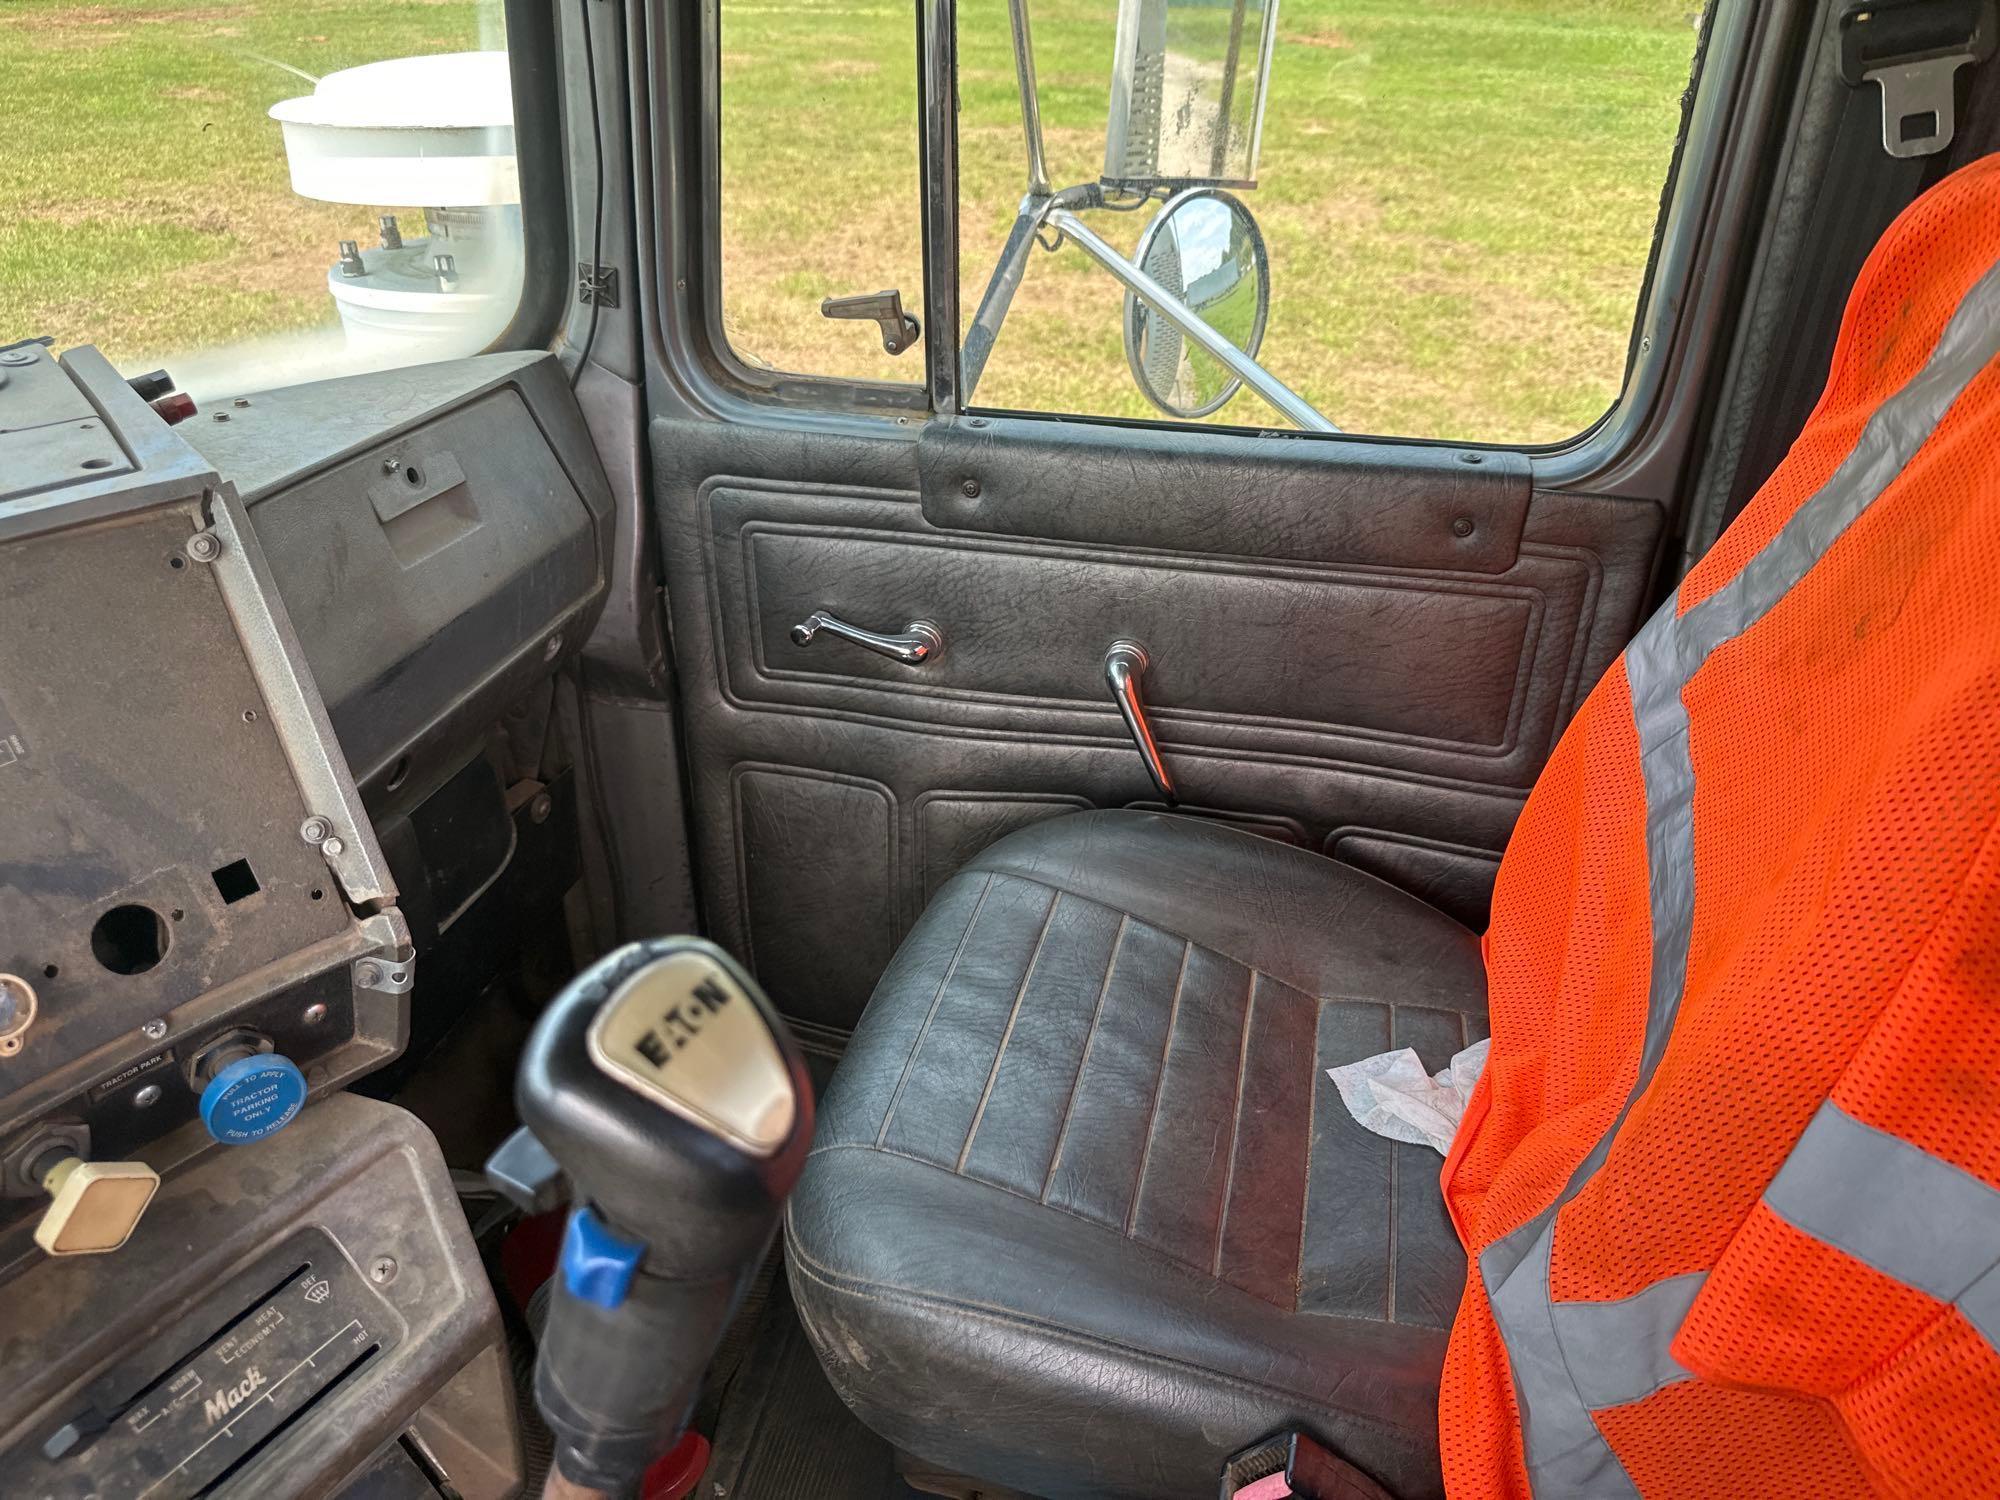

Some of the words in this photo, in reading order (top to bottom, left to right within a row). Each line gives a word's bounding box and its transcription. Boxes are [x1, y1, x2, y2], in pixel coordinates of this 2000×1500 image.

[101, 1066, 139, 1089] TRACTOR
[140, 1055, 162, 1070] PARK
[222, 1084, 241, 1100] PULL
[245, 1074, 257, 1083] TO
[260, 1070, 286, 1079] APPLY
[230, 1084, 278, 1108] TRACTOR
[233, 1093, 279, 1117] PARKING
[244, 1106, 272, 1122] ONLY
[226, 1128, 249, 1138] PUSH
[252, 1128, 264, 1137] TO
[266, 1102, 298, 1131] RELEASE
[301, 1274, 317, 1290] DEF
[255, 1305, 277, 1326] HEAT
[215, 1336, 238, 1356] VENT
[234, 1322, 277, 1358] ECONOMY
[352, 1329, 369, 1344] HOT
[204, 1365, 268, 1425] Mack
